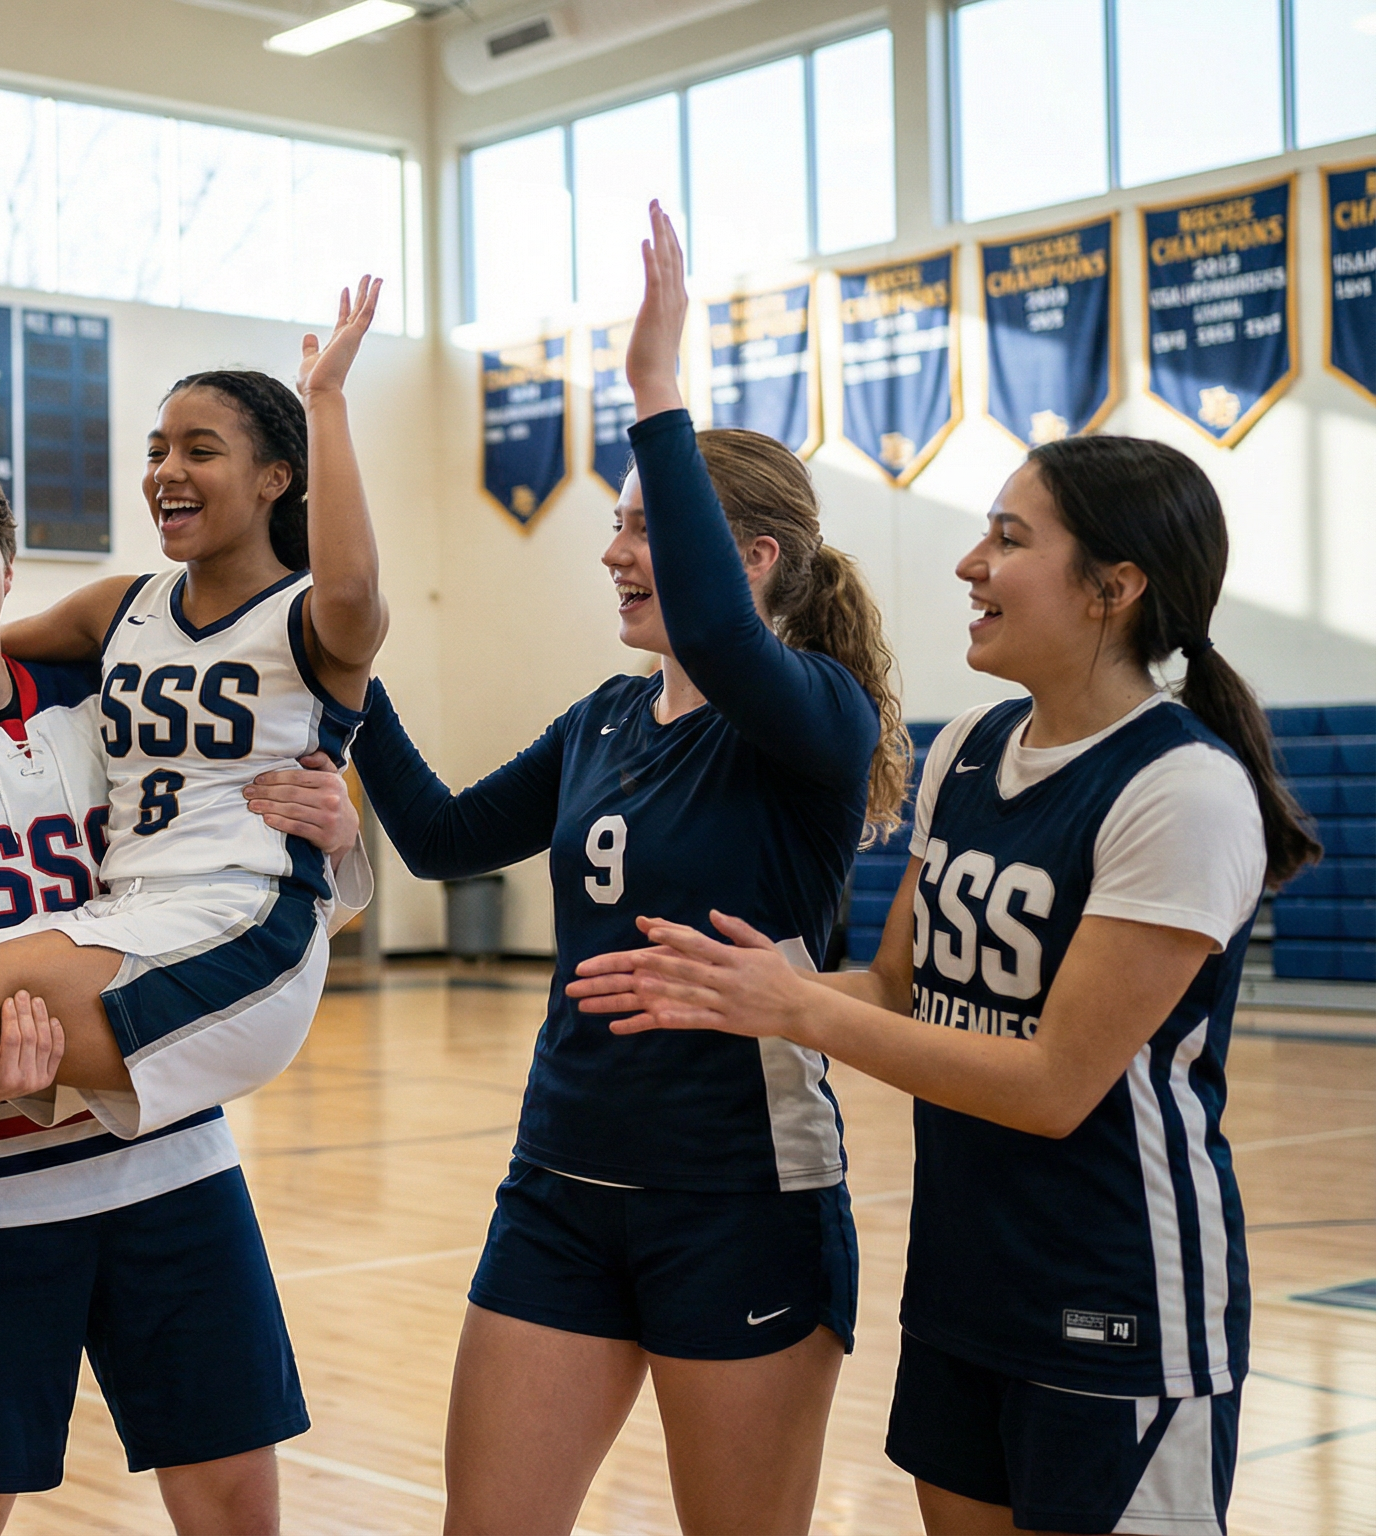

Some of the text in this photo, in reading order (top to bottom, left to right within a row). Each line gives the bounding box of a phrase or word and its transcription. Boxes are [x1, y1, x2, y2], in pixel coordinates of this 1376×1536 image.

[100, 661, 260, 760] SSS
[585, 814, 628, 905] 9
[913, 837, 1055, 1000] SSS
